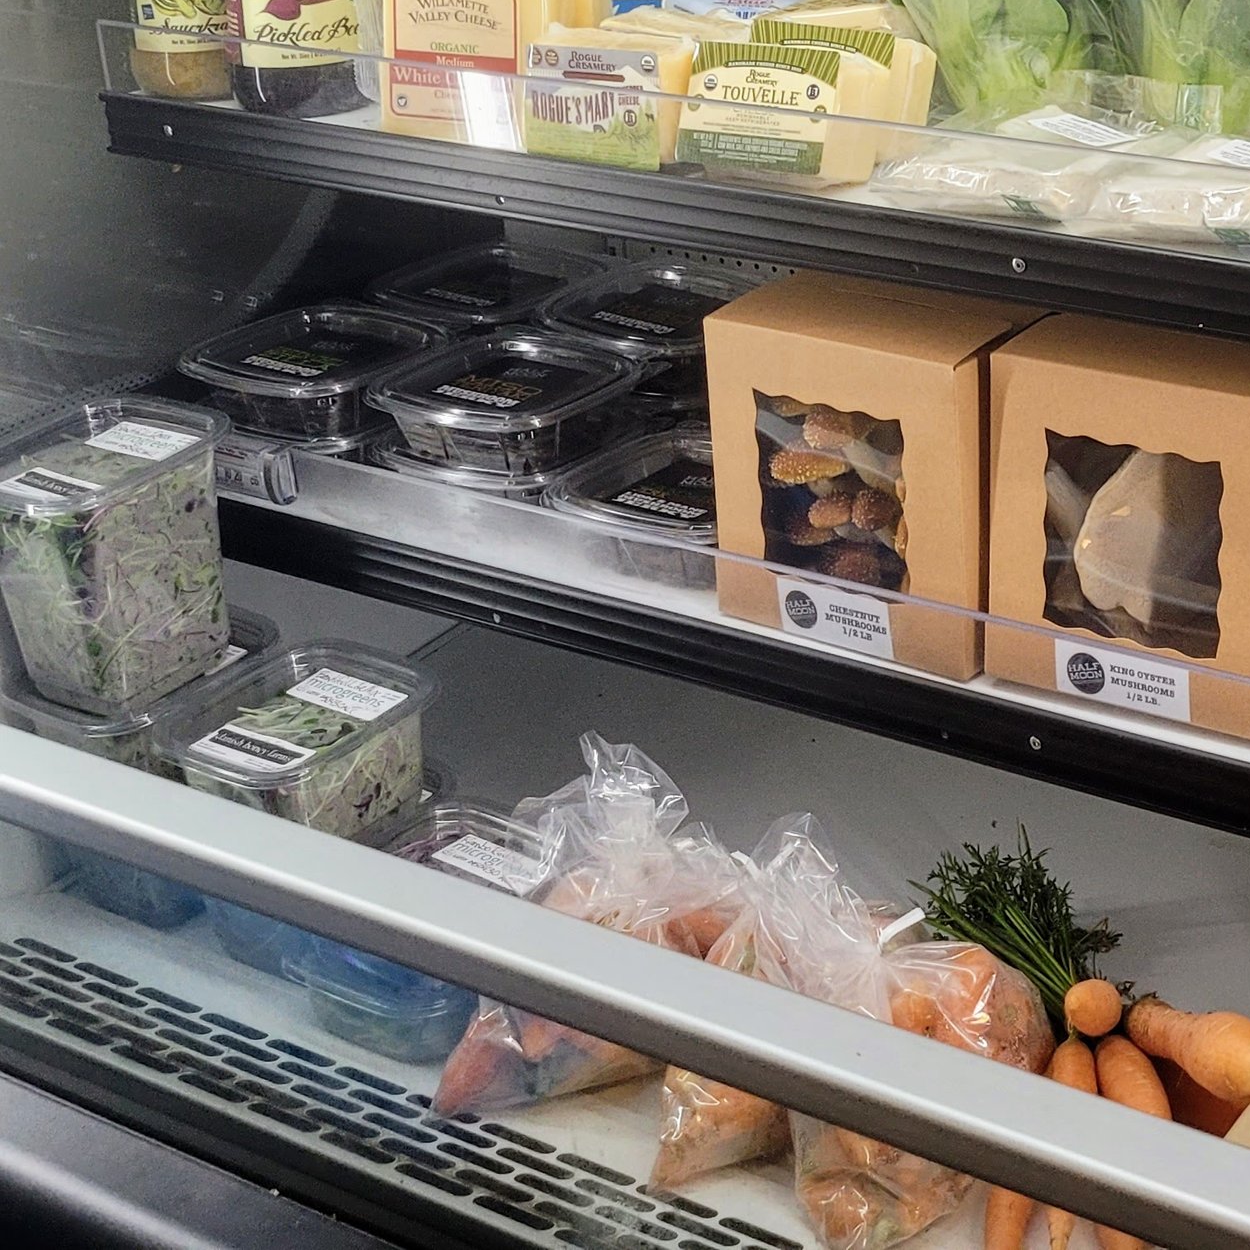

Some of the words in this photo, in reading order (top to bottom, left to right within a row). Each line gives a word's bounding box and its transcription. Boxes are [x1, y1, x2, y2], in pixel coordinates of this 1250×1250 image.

[408, 10, 451, 25] VALLEY
[454, 11, 498, 30] CHEESE
[253, 23, 324, 45] Pickled
[430, 41, 479, 54] ORGANIC
[436, 55, 475, 68] Medium
[571, 51, 603, 63] ROGUE
[568, 60, 617, 73] CREAMERY
[393, 67, 441, 85] White
[722, 85, 799, 106] TOUVELLE
[532, 90, 582, 125] ROGUE'S
[584, 91, 615, 125] MARY
[785, 599, 813, 608] HALF
[787, 606, 816, 616] MOON
[829, 604, 881, 623] CHESTNUT
[825, 613, 887, 635] MUSHROOMS
[1068, 662, 1100, 672] HALF
[1069, 670, 1103, 680] MOON
[1110, 664, 1135, 677] KING
[1137, 671, 1176, 686] OYSTER
[308, 678, 386, 708] microgreens
[1110, 676, 1175, 698] MUSHROOMS
